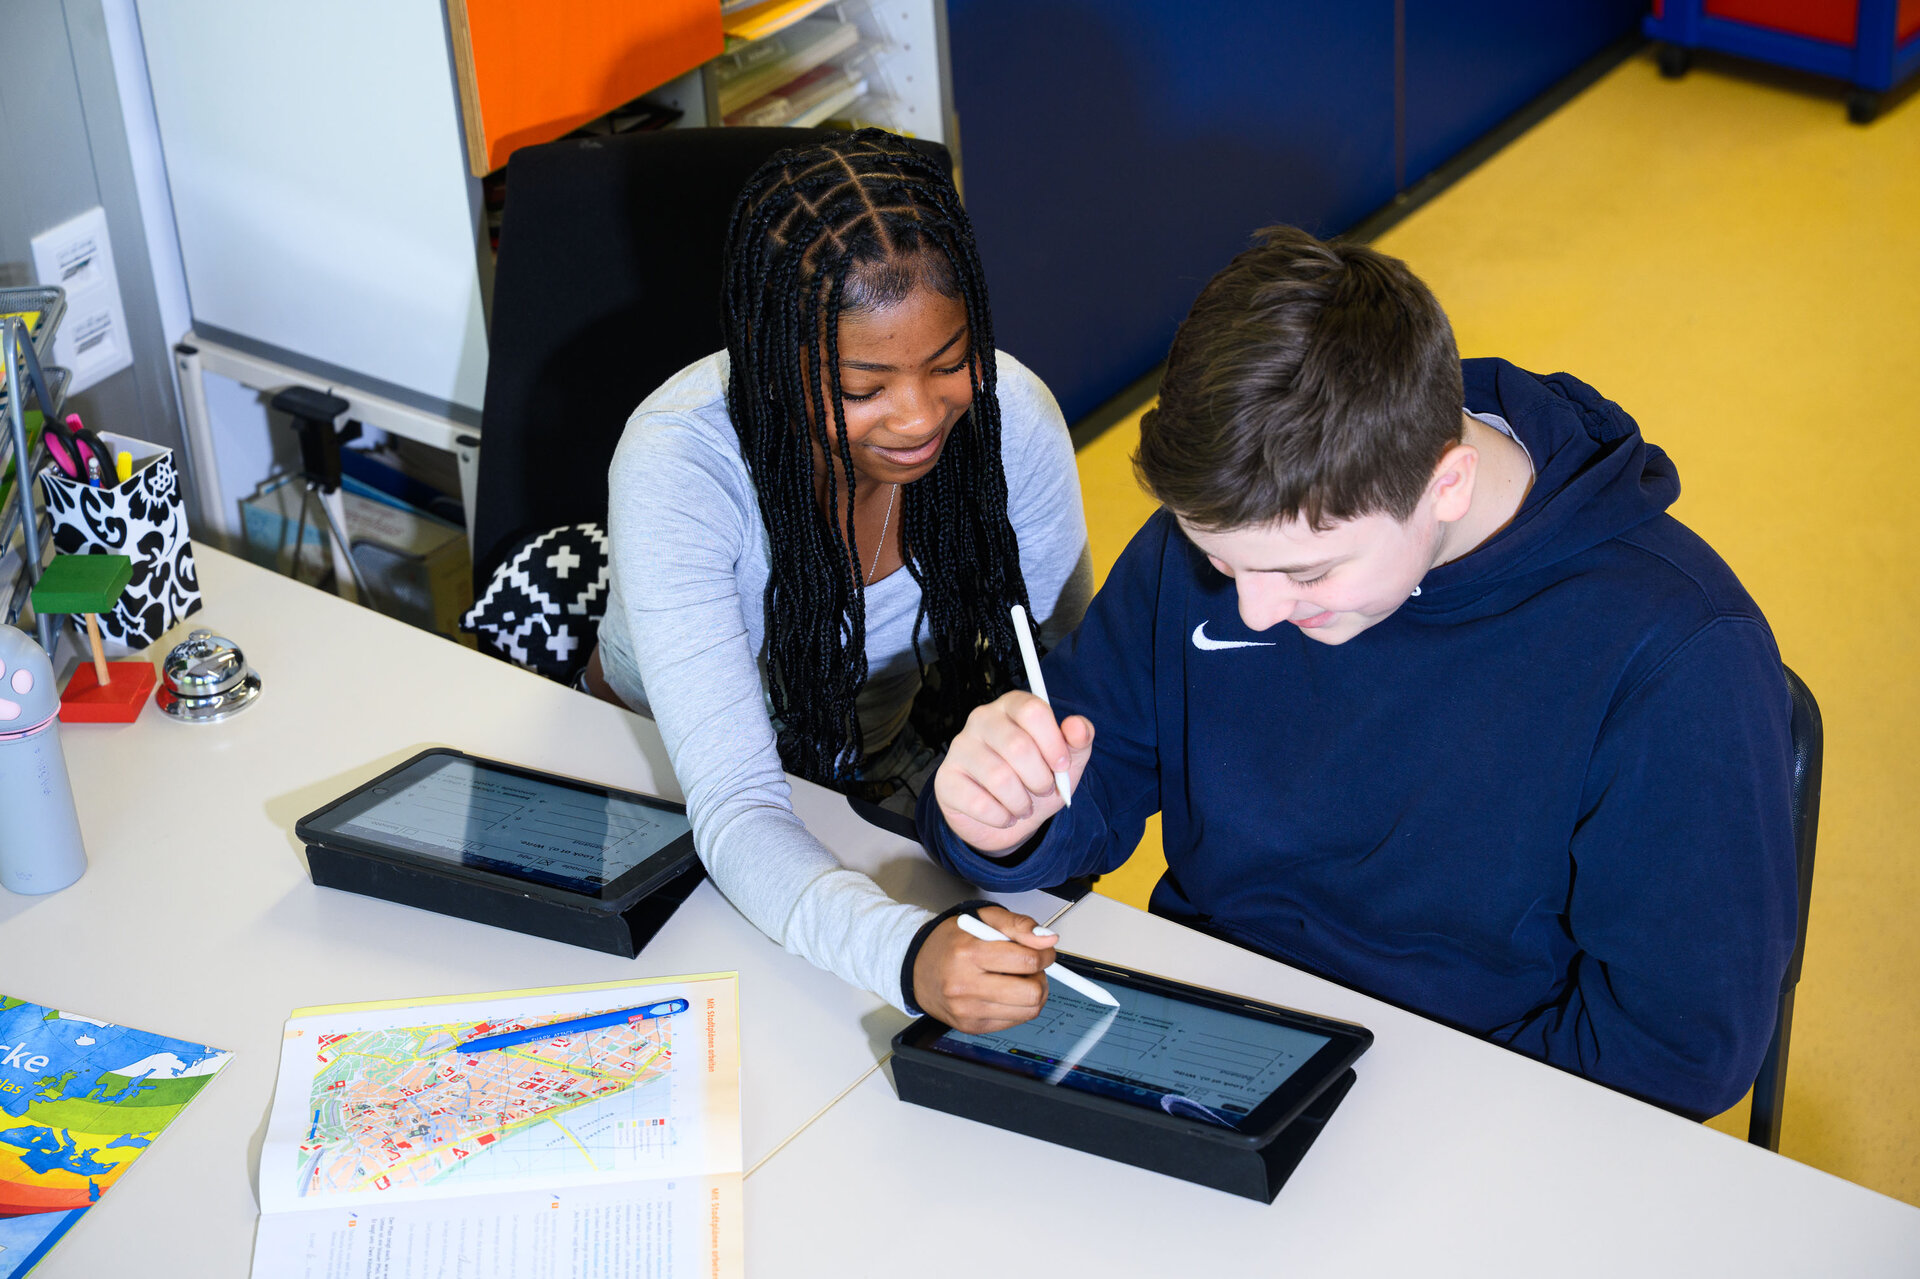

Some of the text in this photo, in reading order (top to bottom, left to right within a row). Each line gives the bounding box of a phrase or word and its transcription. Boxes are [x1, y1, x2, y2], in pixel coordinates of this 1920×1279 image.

[706, 998, 716, 1009] Mit
[707, 1049, 716, 1073] arbeiten
[0, 1079, 24, 1094] las
[711, 1187, 720, 1200] Mit
